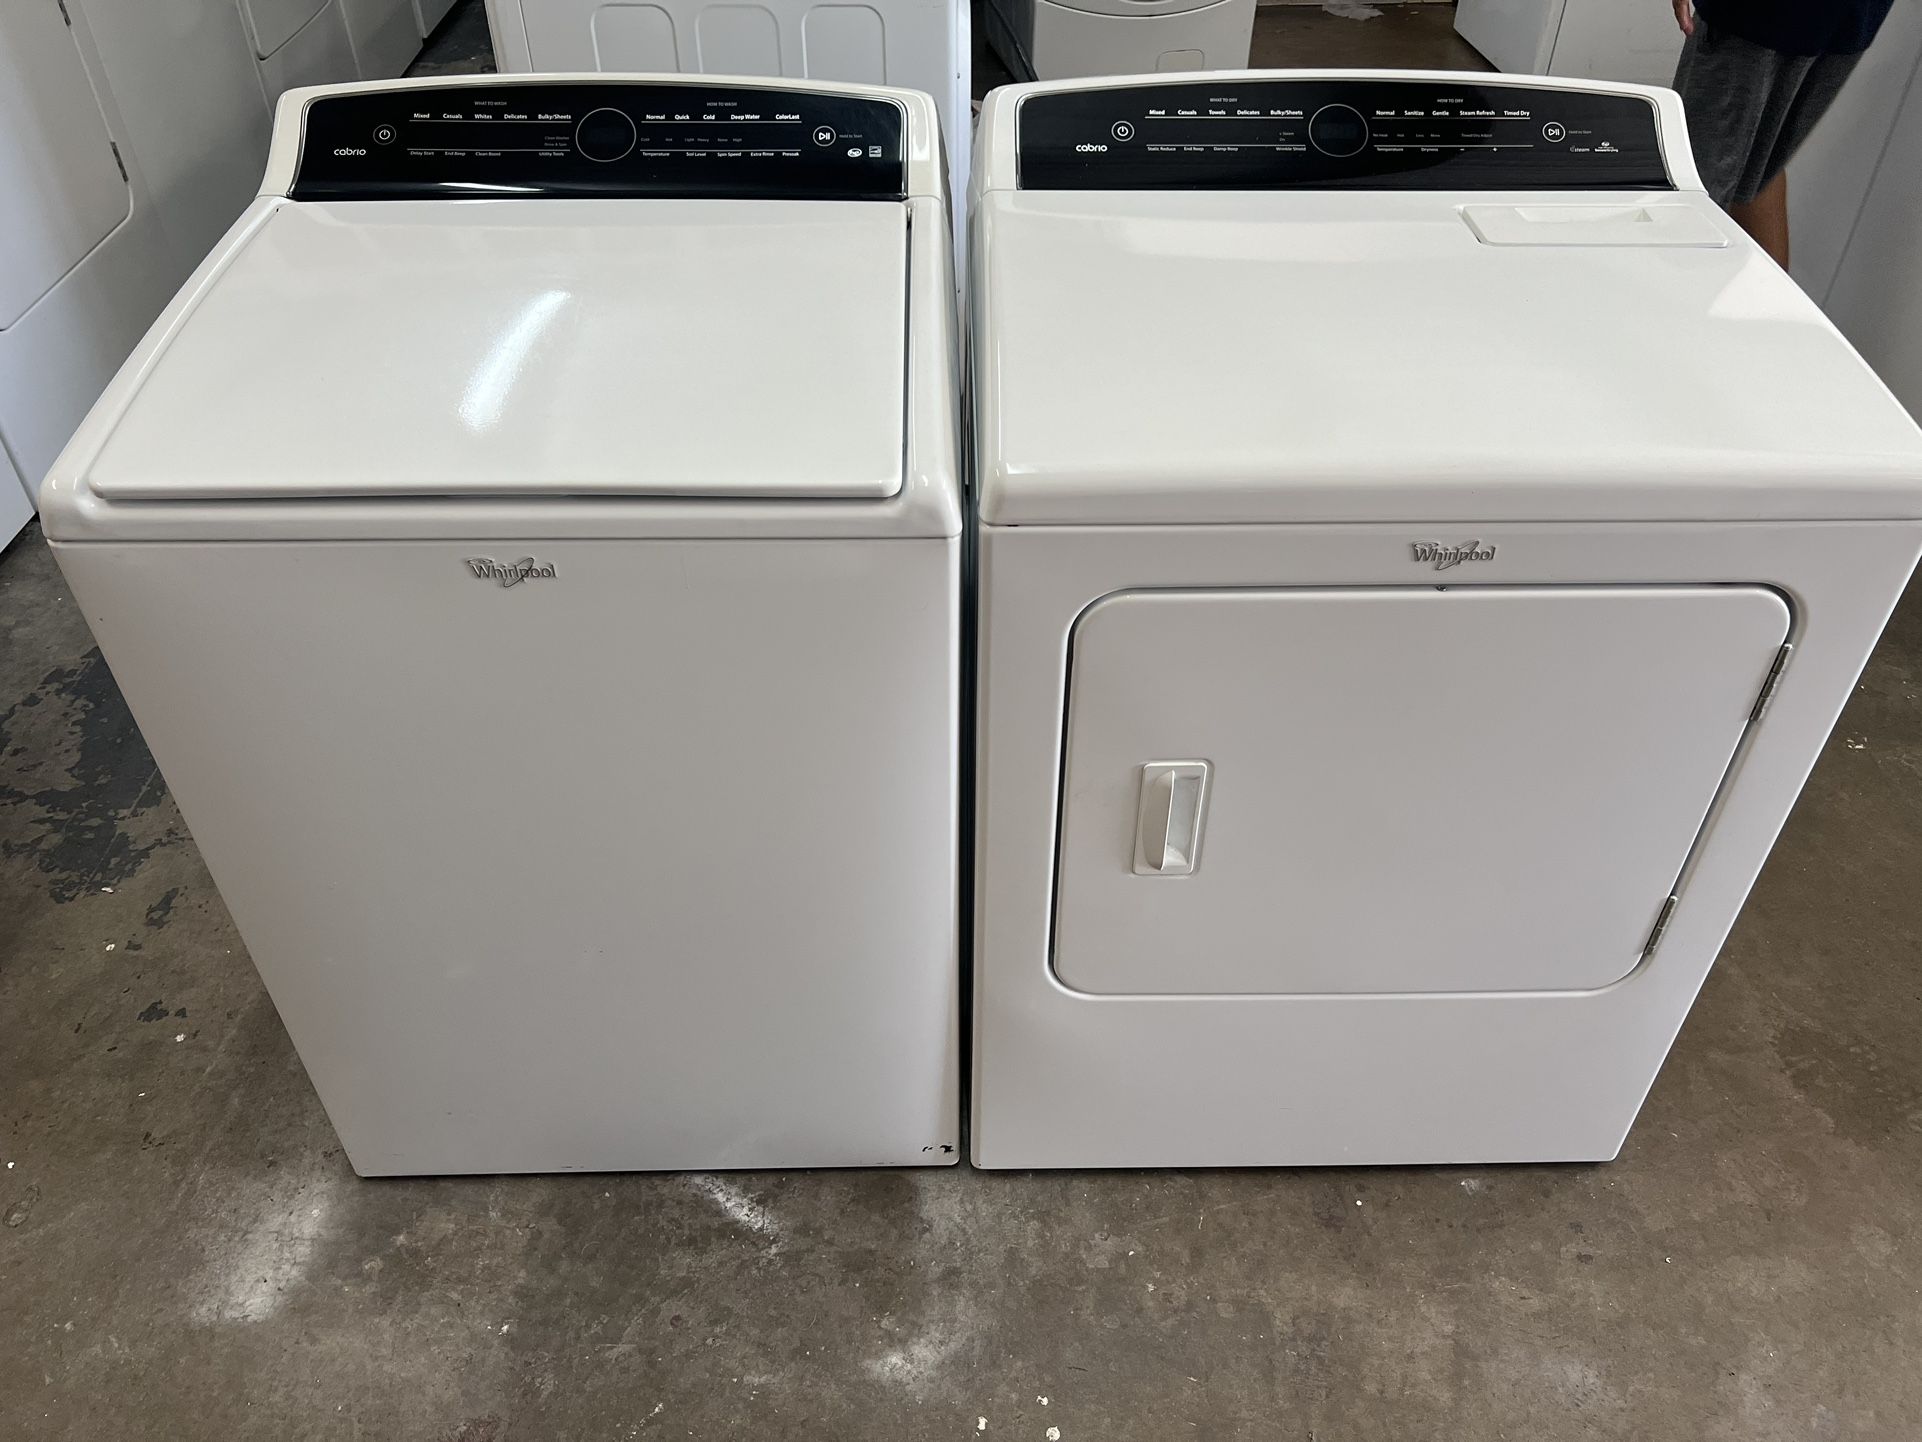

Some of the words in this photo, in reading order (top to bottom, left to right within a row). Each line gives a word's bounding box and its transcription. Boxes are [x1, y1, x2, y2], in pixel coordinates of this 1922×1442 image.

[334, 147, 366, 156] cabrio
[1076, 143, 1108, 152] cabrio
[1413, 543, 1496, 567] Whirlpool
[470, 560, 558, 583] Whirlpool
